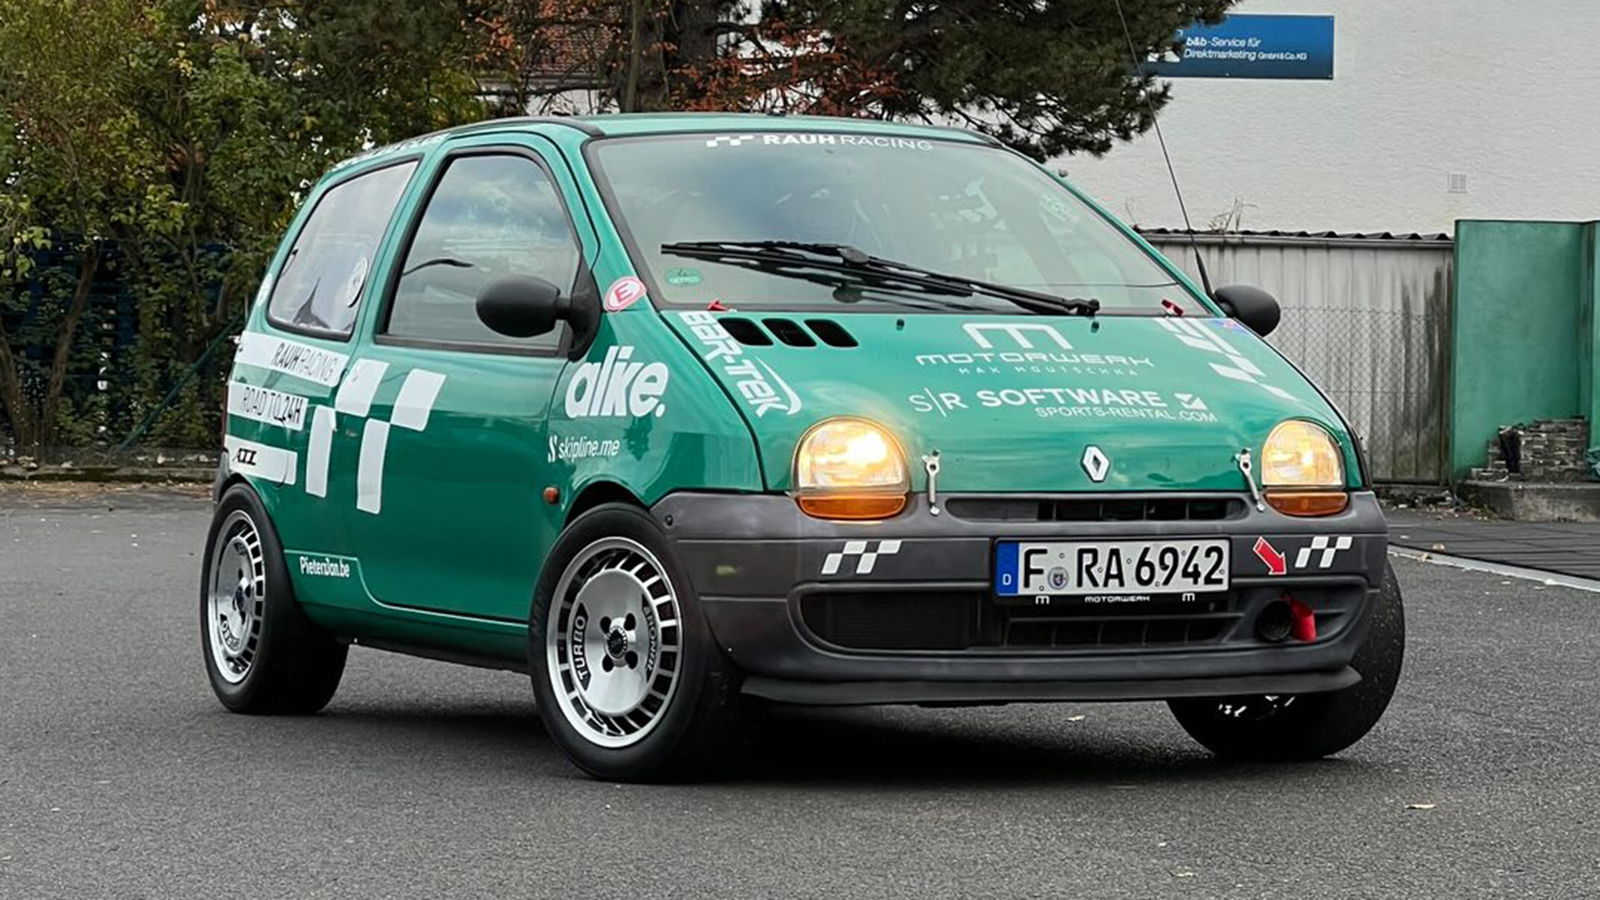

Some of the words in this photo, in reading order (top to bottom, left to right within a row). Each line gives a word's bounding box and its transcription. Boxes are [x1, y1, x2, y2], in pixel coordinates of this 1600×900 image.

[1247, 37, 1261, 47] für
[1183, 48, 1256, 61] Direktmarketing
[762, 133, 836, 146] RAUH
[839, 136, 933, 151] RACING
[613, 283, 633, 303] E
[299, 347, 339, 382] RACING
[564, 345, 669, 419] alike.
[240, 385, 268, 416] ROAD
[976, 388, 1168, 408] SOFTWARE
[1034, 406, 1218, 424] SPORTS-RENTAL.COM
[558, 435, 621, 461] skipline.me
[299, 555, 351, 578] PieterJan.be
[1023, 548, 1048, 589] F
[1076, 547, 1126, 588] RA
[1135, 545, 1225, 587] 6942
[1001, 573, 1012, 586] D
[572, 614, 587, 681] TURBO
